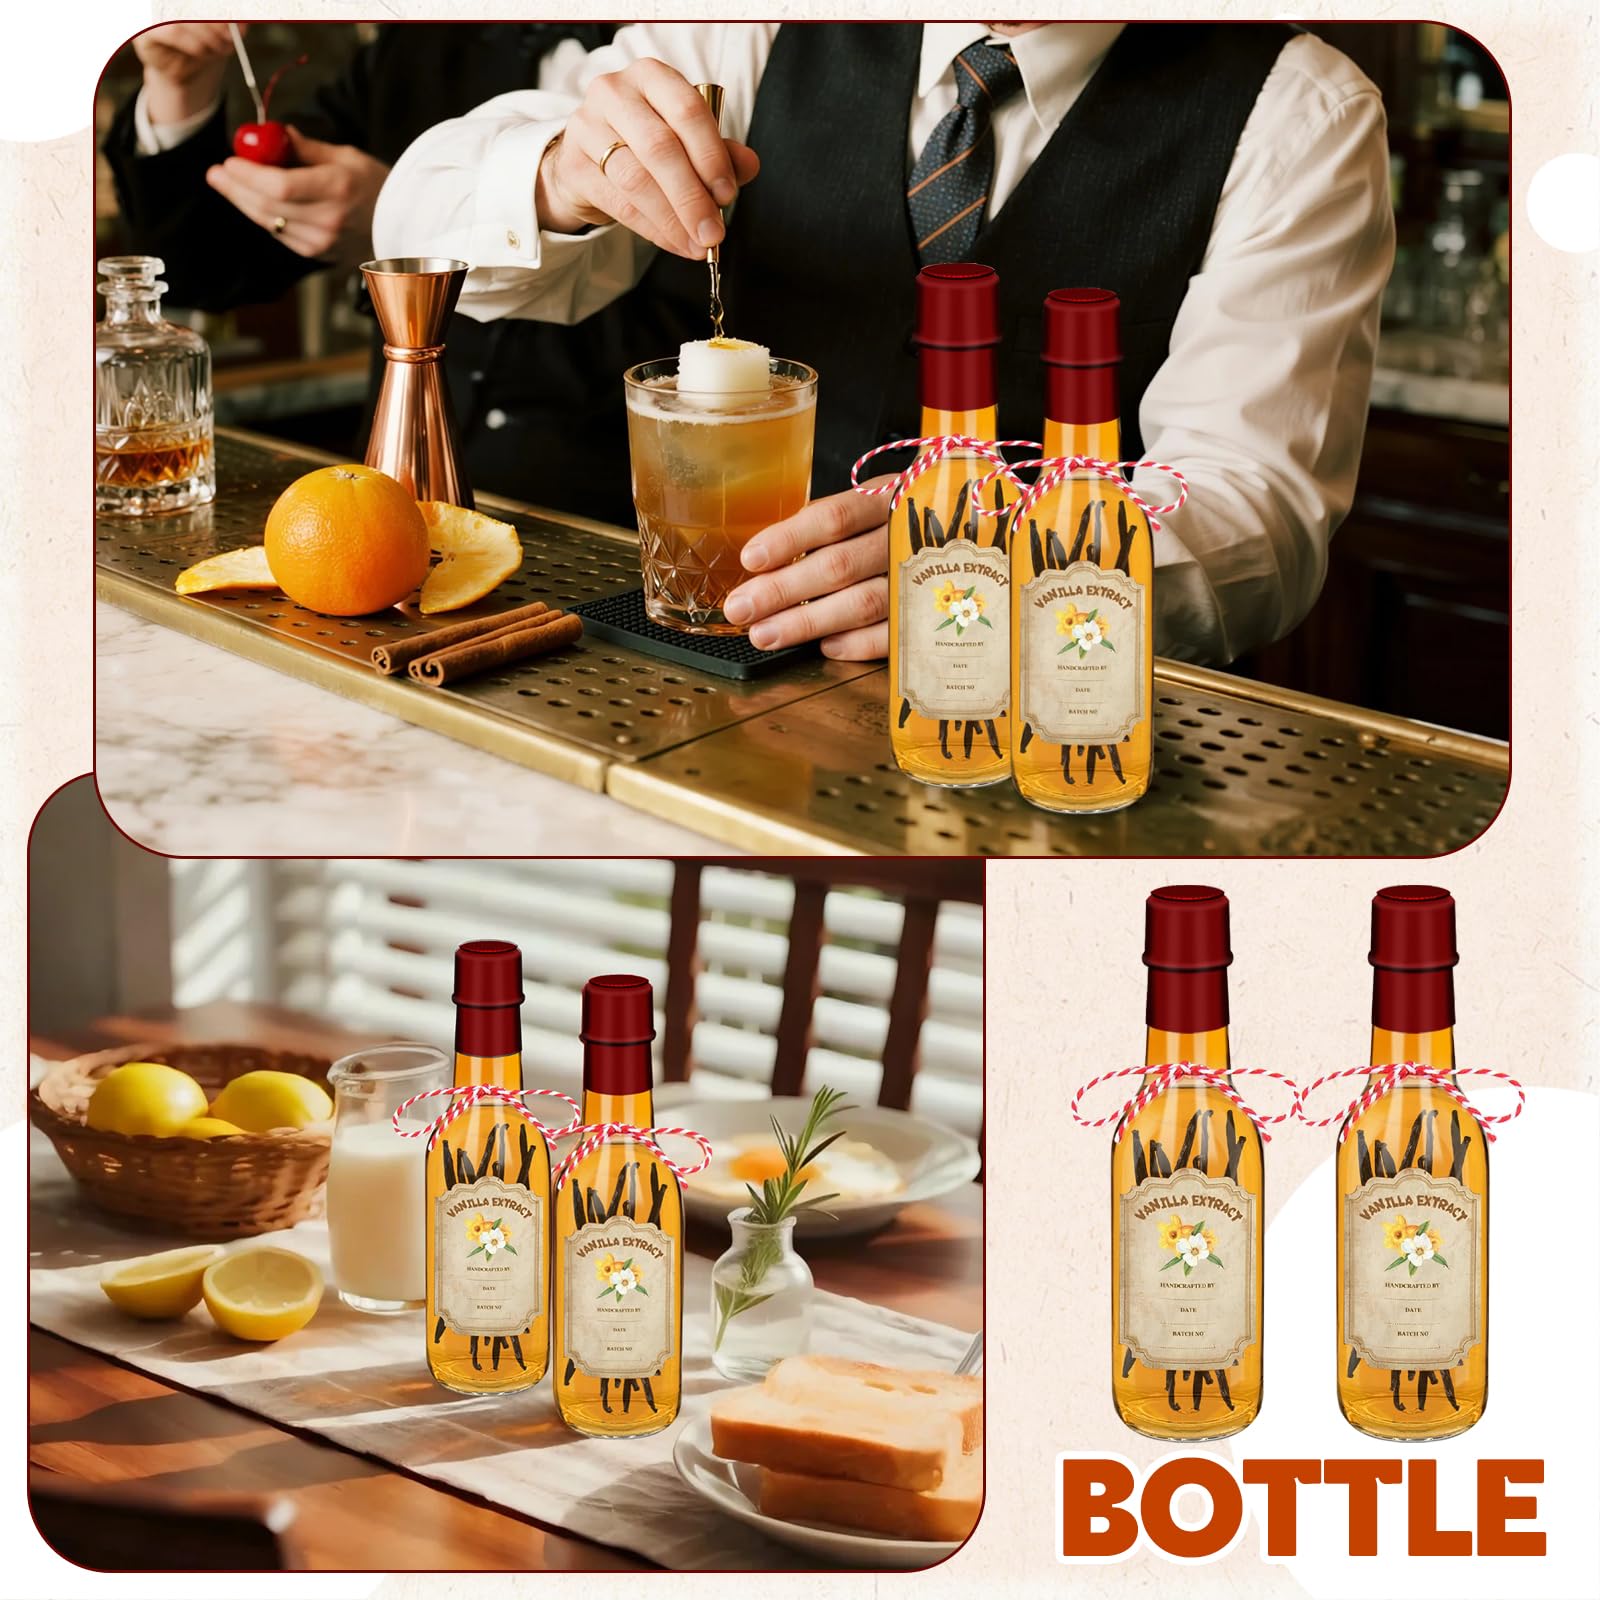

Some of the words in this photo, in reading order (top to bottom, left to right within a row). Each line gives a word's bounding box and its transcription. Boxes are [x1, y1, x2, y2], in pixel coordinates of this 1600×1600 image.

[912, 562, 961, 586] VANILLA
[964, 562, 1009, 587] EXTRACT
[1034, 585, 1083, 609] VANILLA
[1086, 585, 1133, 610] EXTRACT
[446, 1197, 489, 1218] VANILLA
[491, 1197, 533, 1219] EXTRACT
[1134, 1194, 1189, 1221] VANILLA
[1192, 1194, 1243, 1222] EXTRACT
[1358, 1194, 1414, 1221] VANILLA
[1416, 1194, 1468, 1222] EXTRACT
[576, 1237, 620, 1258] VANILLA
[622, 1237, 664, 1259] EXTRACT
